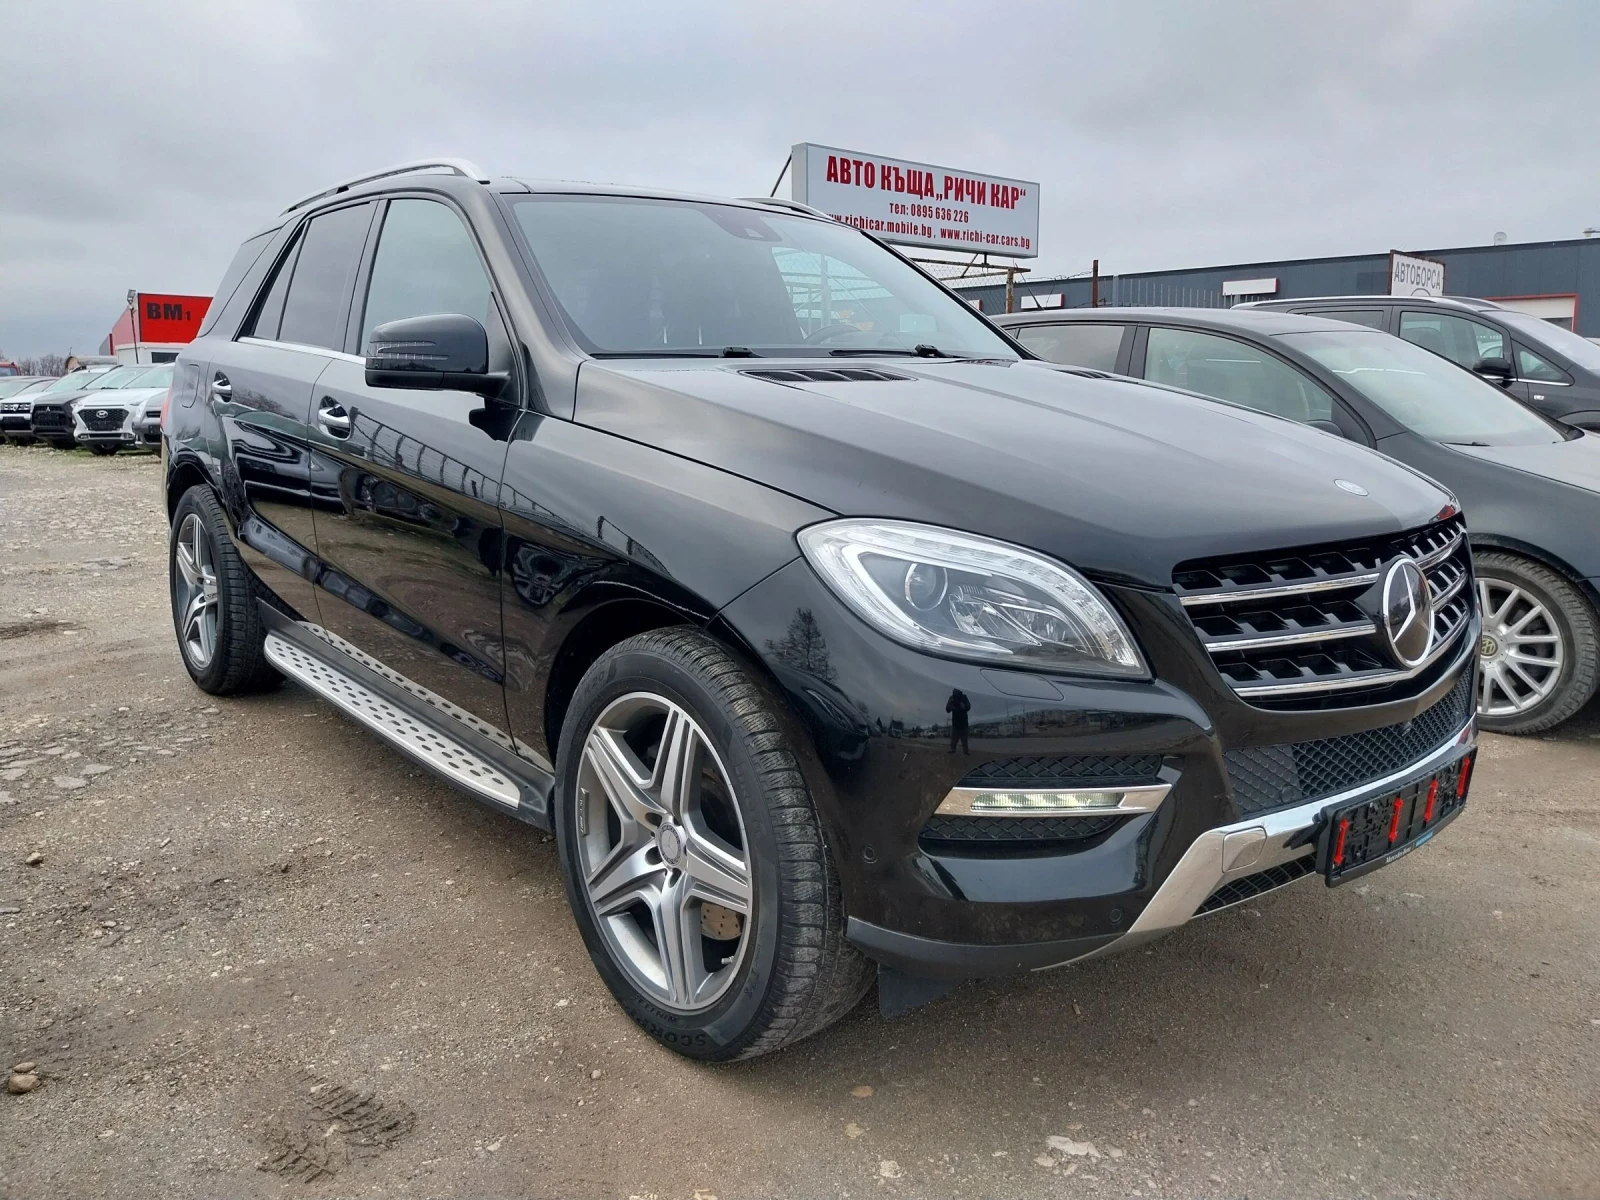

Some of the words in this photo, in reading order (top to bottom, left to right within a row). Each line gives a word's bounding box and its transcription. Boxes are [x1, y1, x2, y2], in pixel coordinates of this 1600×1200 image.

[826, 155, 876, 189] АВТО
[889, 202, 909, 216] тел:
[910, 203, 933, 219] 0895
[935, 206, 952, 222] 636
[953, 209, 969, 224] 226
[940, 227, 1031, 250] www.richi-car.cars.bg
[1393, 261, 1441, 290] АВТОБОРСА
